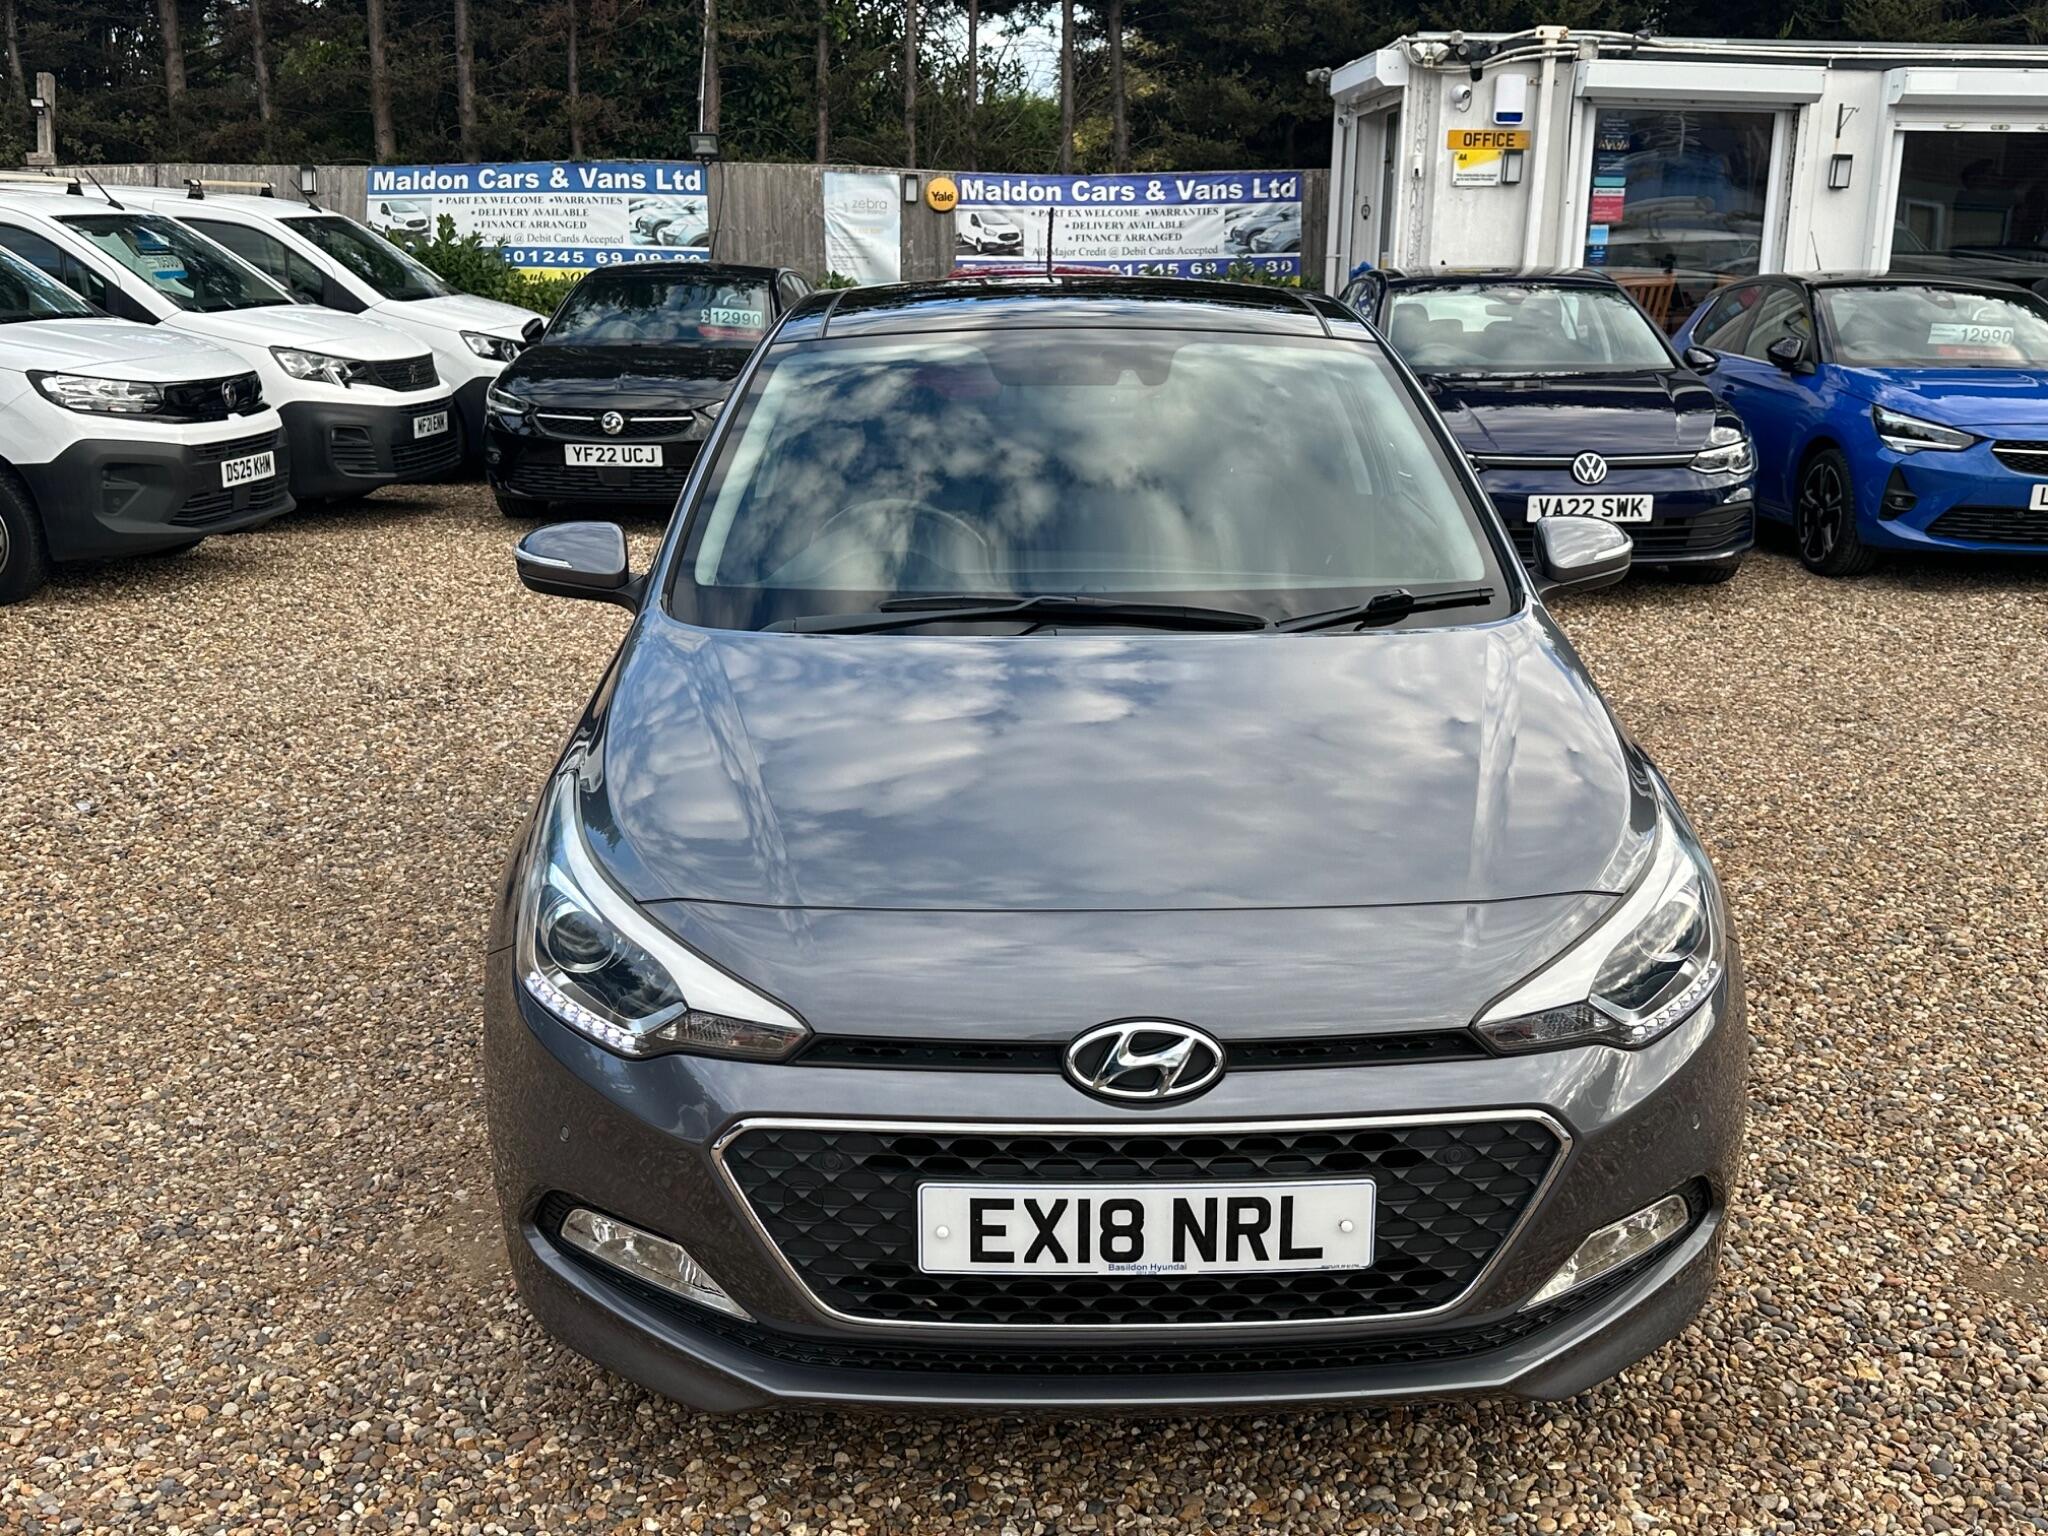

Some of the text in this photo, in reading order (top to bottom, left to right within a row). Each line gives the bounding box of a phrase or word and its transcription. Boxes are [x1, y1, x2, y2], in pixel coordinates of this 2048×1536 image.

[1463, 132, 1516, 147] OFFICE
[373, 167, 701, 191] Maldon Cars & Vans Ltd
[961, 176, 1297, 202] Maldon Cars & Vans Ltd
[446, 196, 470, 205] PART
[475, 196, 487, 205] EX
[490, 196, 545, 205] WELCOME
[931, 191, 954, 202] Yale
[851, 198, 888, 210] zebra
[478, 208, 590, 217] DELIVERY AVAILABLE
[1068, 209, 1082, 218] EX
[1085, 209, 1140, 218] WELCOME
[481, 220, 587, 230] FINANCE ARRANGED
[1072, 220, 1185, 230] DELIVERY AVAILABLE
[527, 233, 551, 243] Debit
[554, 234, 580, 243] Cards
[583, 234, 624, 246] Accepted
[1075, 233, 1182, 243] FINANCE ARRANGED
[1078, 247, 1106, 256] Credit
[1122, 246, 1146, 256] Debit
[1149, 246, 1175, 256] Cards
[1176, 245, 1218, 257] Accepted
[596, 251, 623, 264] 69
[1961, 327, 2013, 345] 12990
[572, 446, 655, 463] YF22 UCJ
[226, 453, 272, 482] DS25 KHM
[1538, 497, 1644, 517] VA22 SWK
[969, 1195, 1324, 1264] EX18 NRL
[1108, 1263, 1188, 1273] Basildon Hyundai
